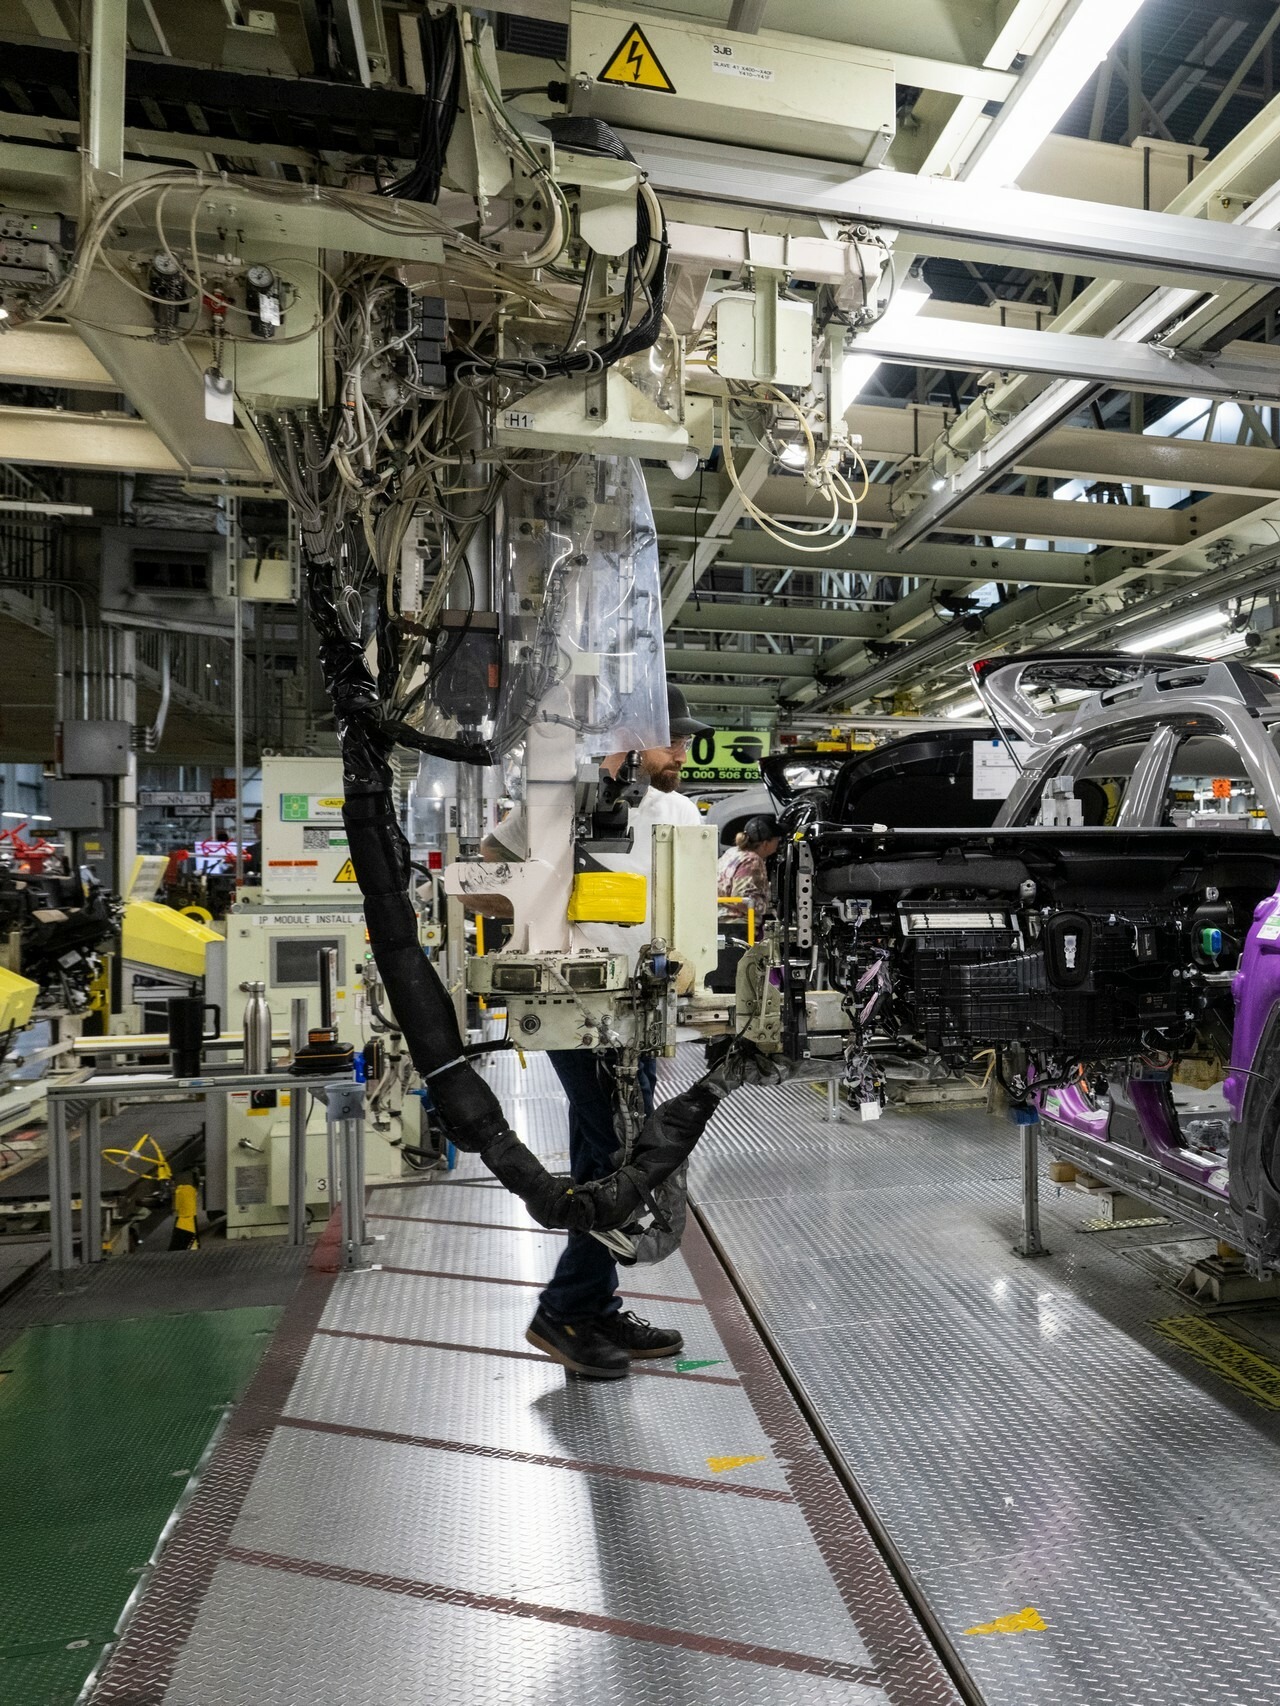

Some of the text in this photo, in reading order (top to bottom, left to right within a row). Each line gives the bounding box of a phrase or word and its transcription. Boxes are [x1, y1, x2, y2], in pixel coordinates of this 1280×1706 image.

[713, 45, 732, 56] 3JB
[510, 413, 526, 427] H1
[274, 916, 310, 924] MODULE
[316, 915, 352, 923] INSTALL
